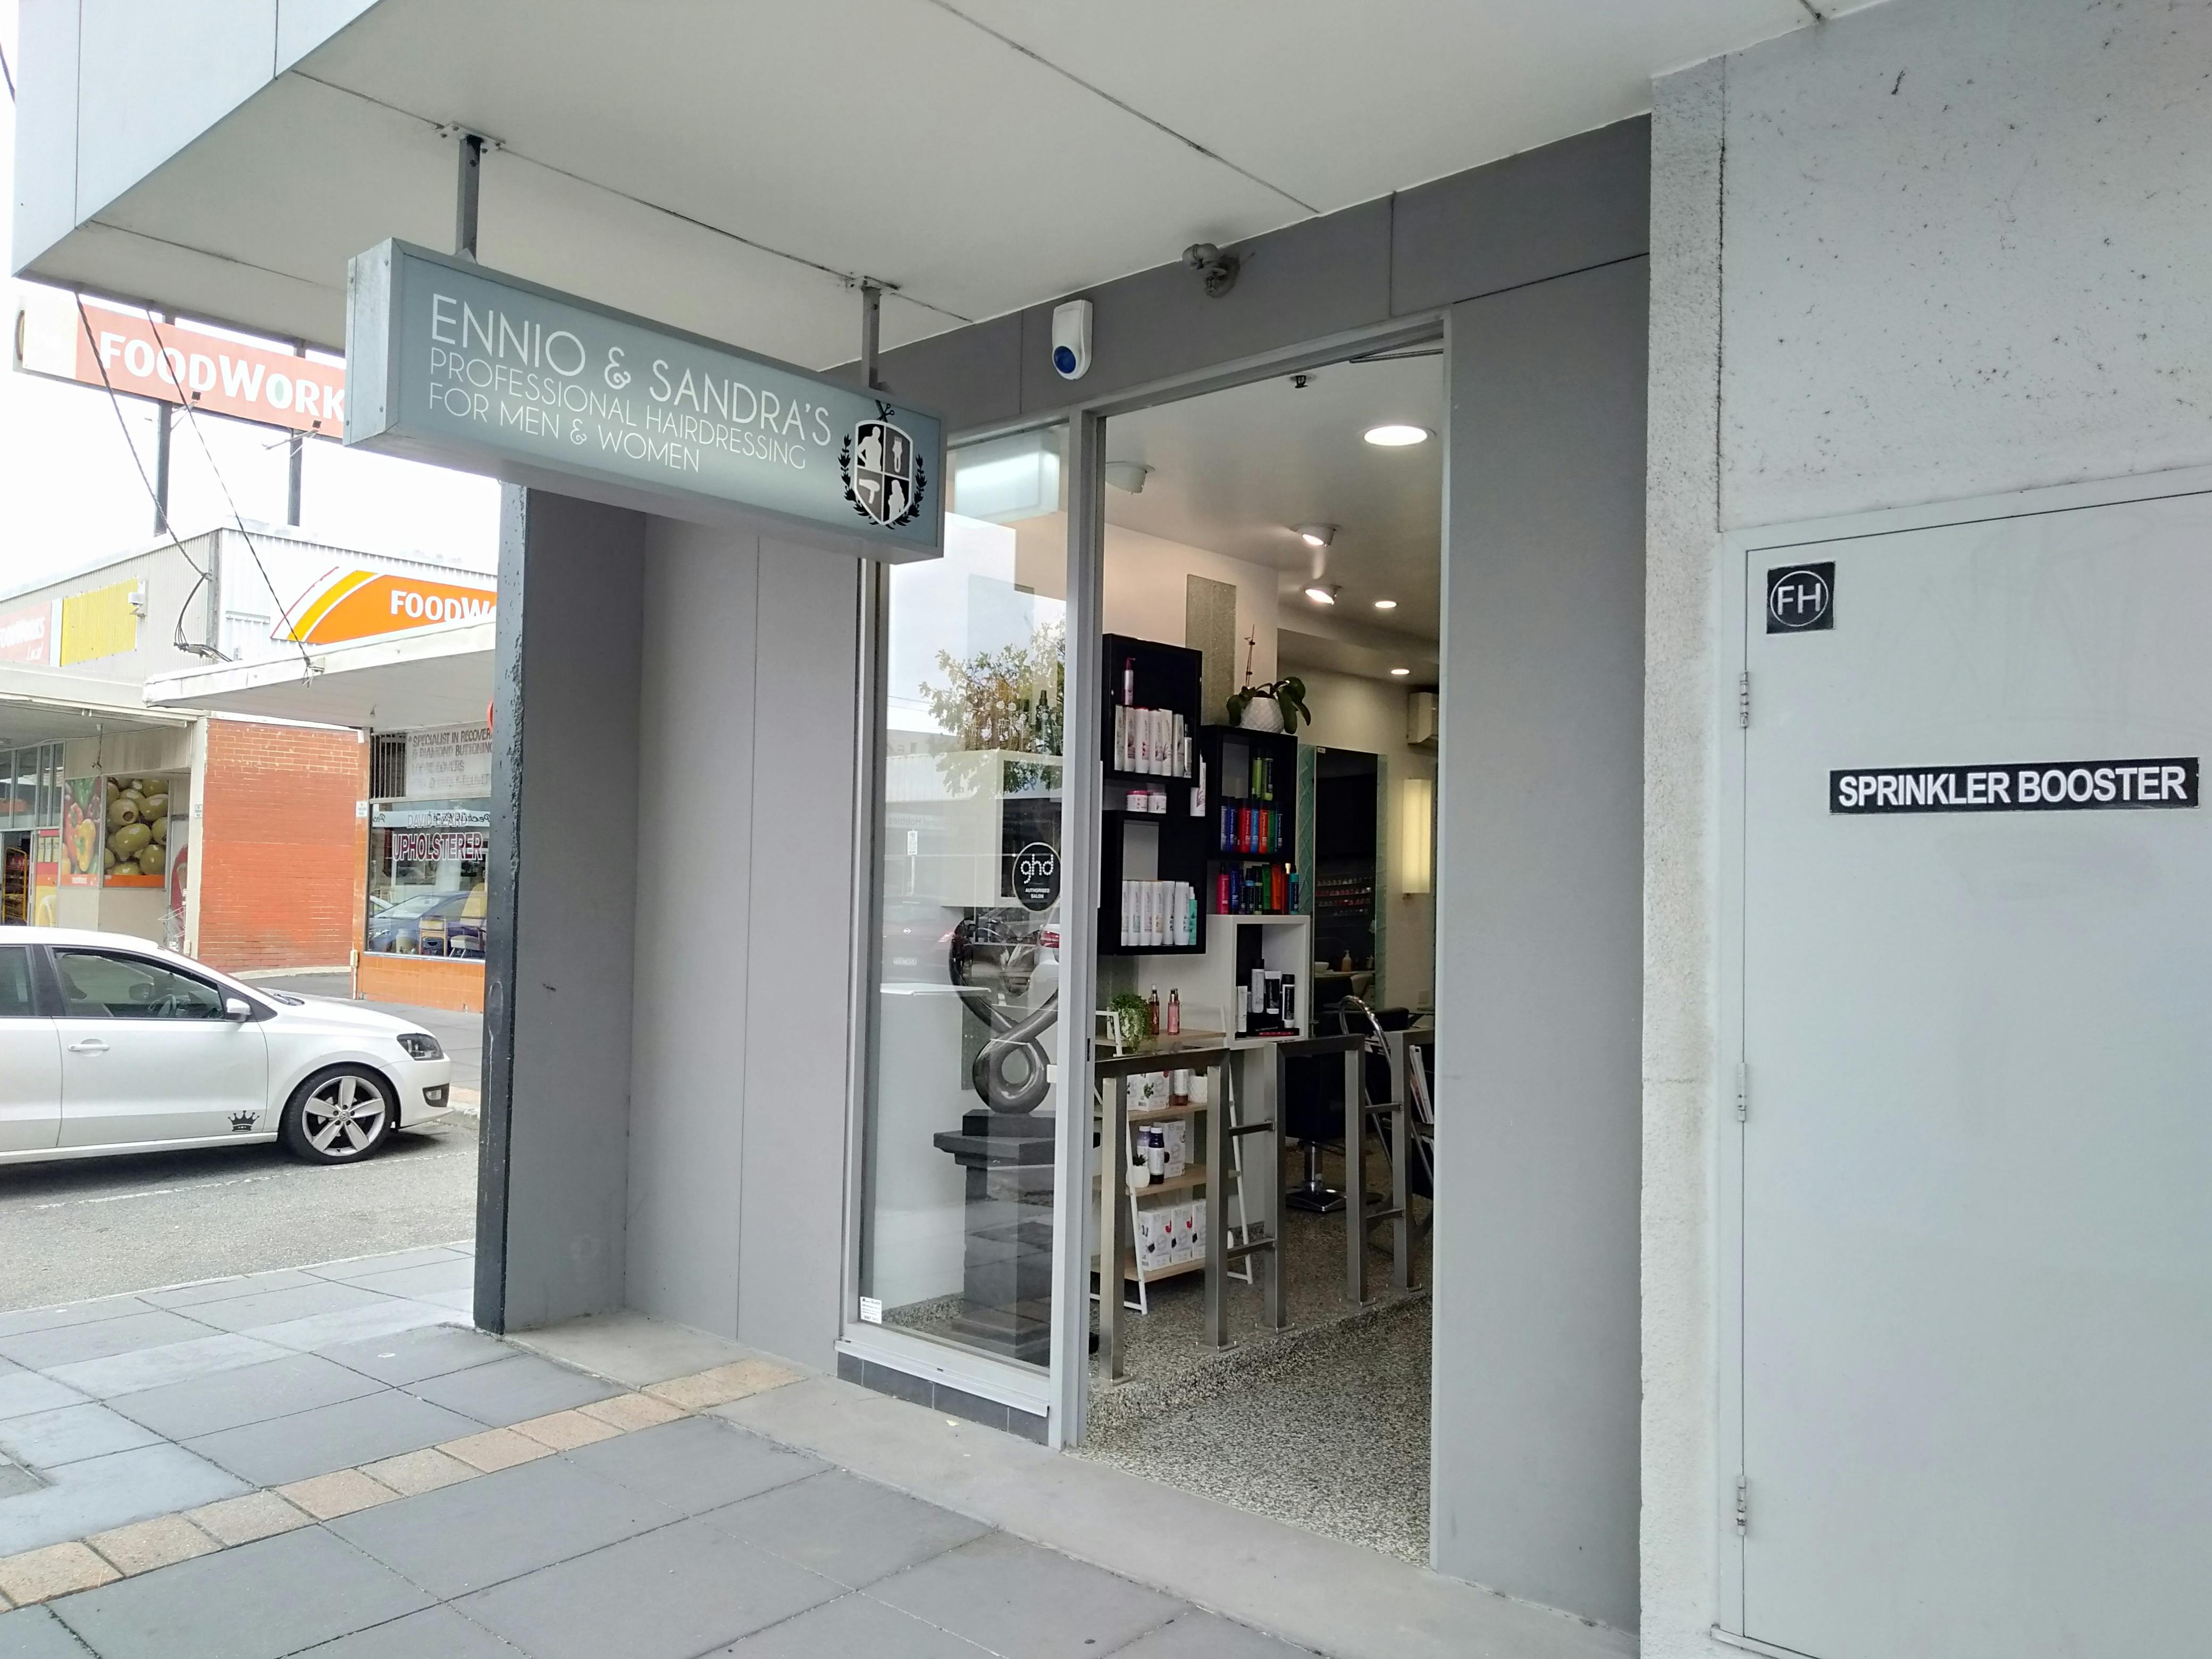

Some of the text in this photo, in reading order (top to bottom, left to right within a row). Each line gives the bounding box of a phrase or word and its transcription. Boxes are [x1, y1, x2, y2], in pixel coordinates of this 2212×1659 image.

[431, 293, 832, 446] ENNIO & SANDRA'S
[430, 347, 807, 470] PROFESSIONAL HAIRDRESSING
[430, 383, 700, 473] FOR MEN & WOMEN
[1777, 583, 1822, 615] FH
[413, 728, 492, 748] SPECIALIST IN RECOVER
[420, 745, 454, 759] DIAMOND
[1838, 766, 2188, 807] SPRINKLER BOOSTER
[407, 814, 433, 829] DAVID
[392, 832, 483, 861] UPHOLSTERER
[1020, 853, 1054, 884] ghd
